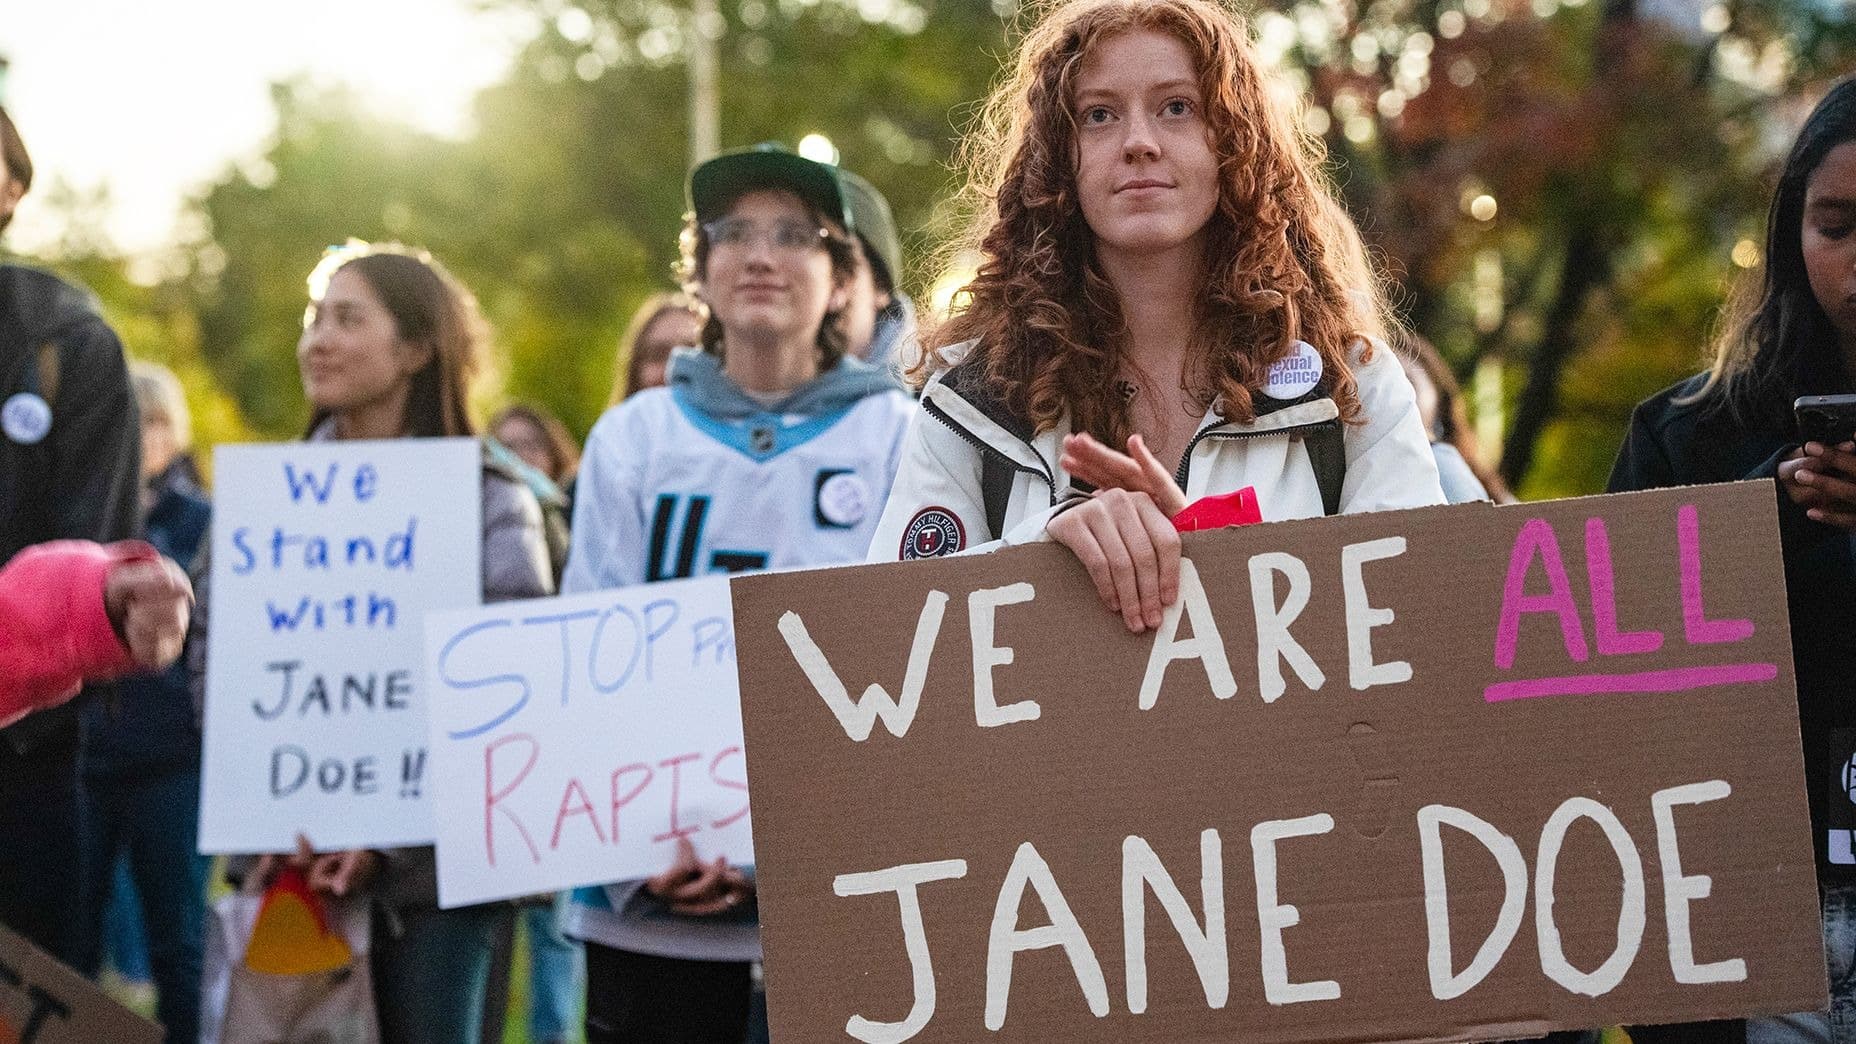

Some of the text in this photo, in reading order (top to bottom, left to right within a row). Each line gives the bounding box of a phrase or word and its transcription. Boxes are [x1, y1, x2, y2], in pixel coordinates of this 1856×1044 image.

[1268, 356, 1312, 372] exual
[285, 464, 376, 504] We
[232, 520, 416, 574] Stand
[906, 514, 957, 550] TOMMY HILFIGER
[778, 505, 1754, 742] WE ARE ALL
[252, 661, 411, 720] JANE
[438, 598, 679, 741] STOP
[270, 744, 376, 798] DOE
[833, 780, 1747, 1044] JANE DOE
